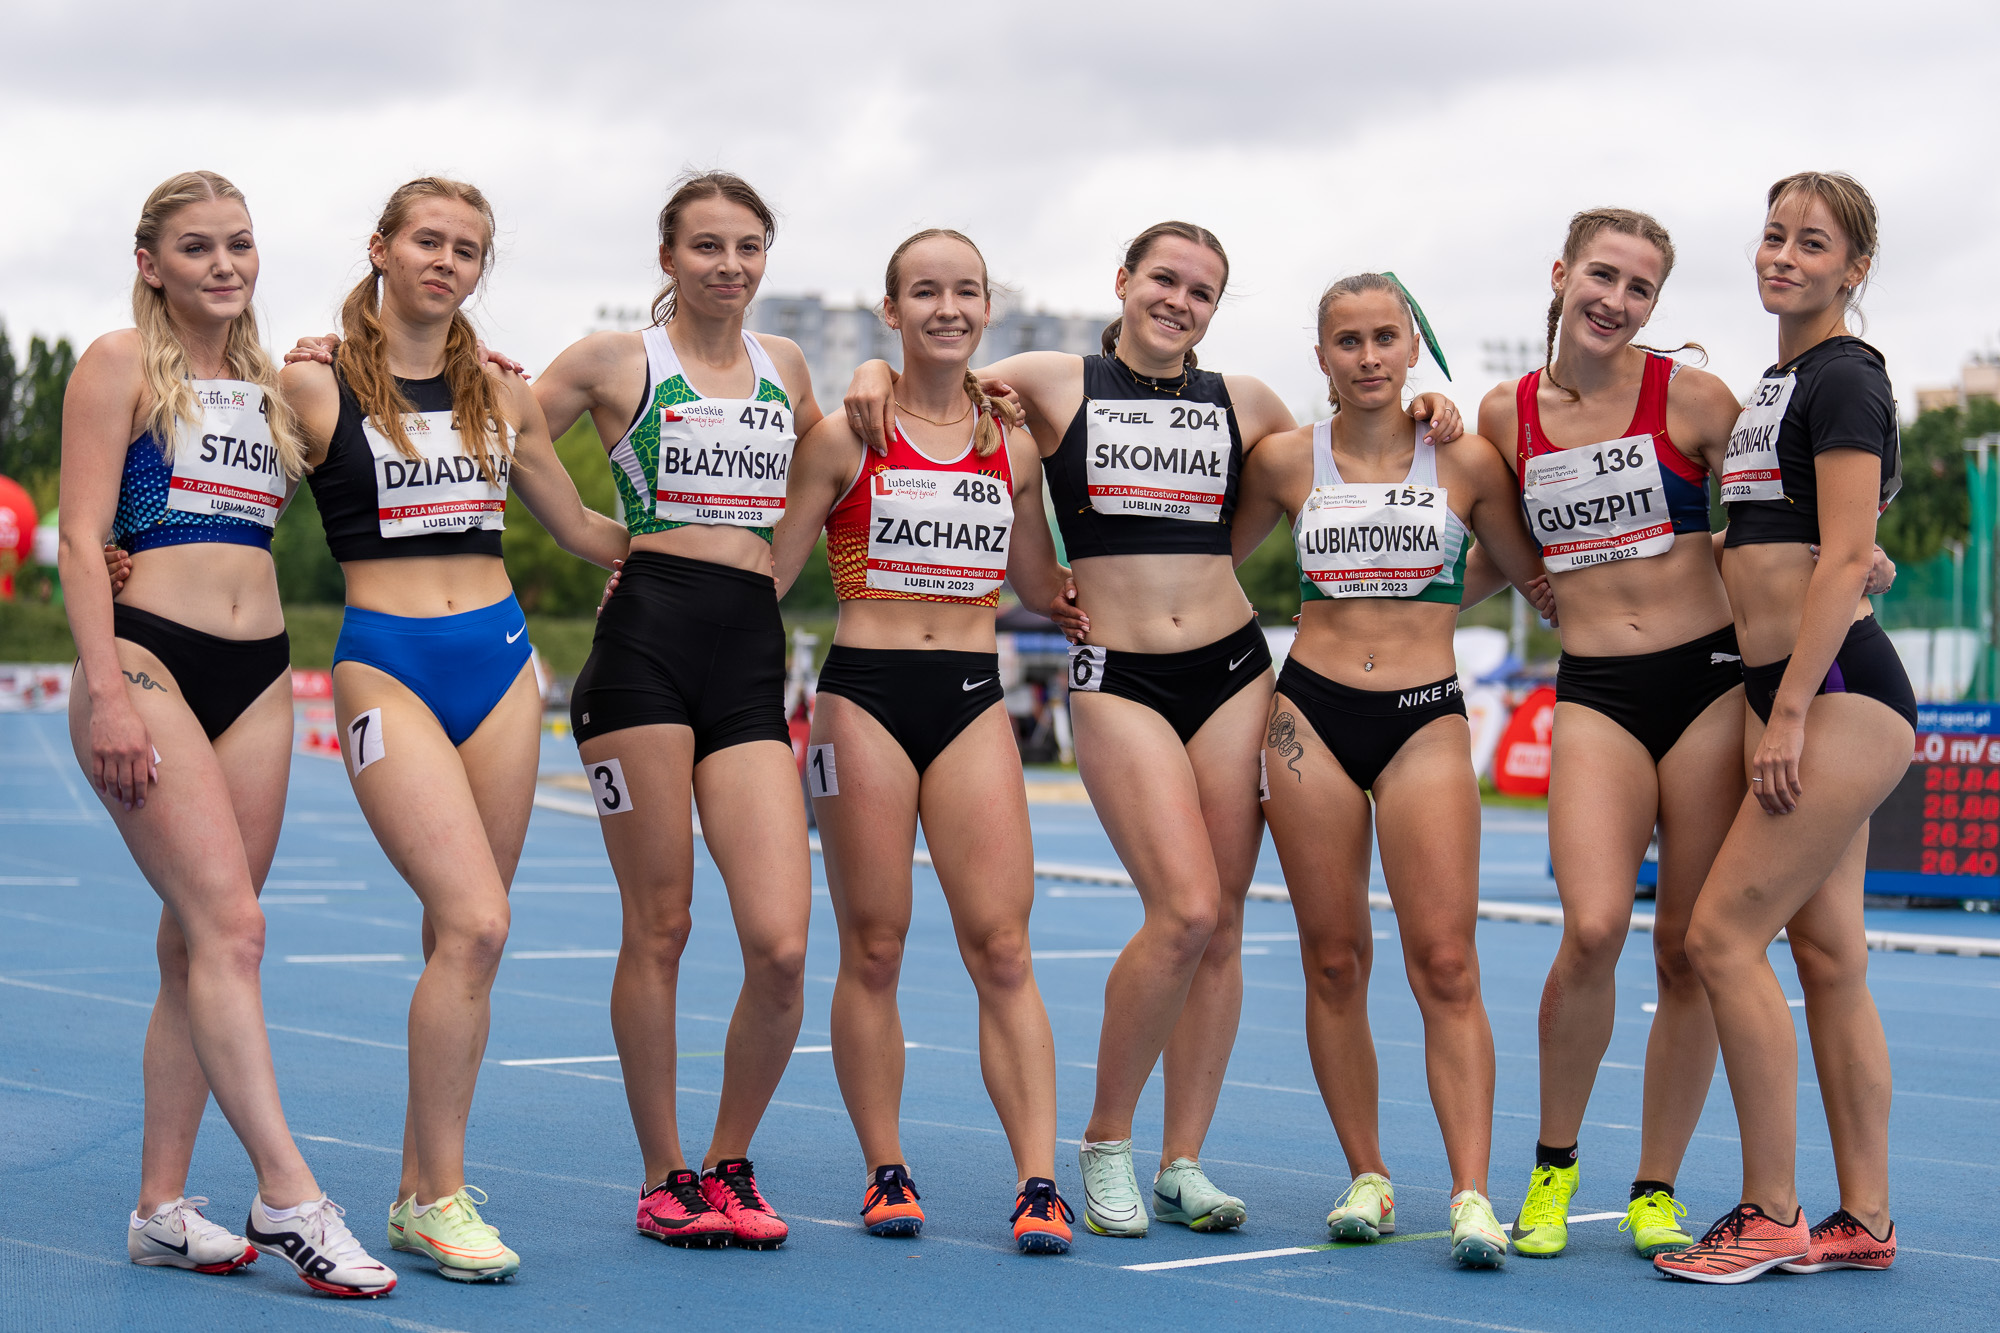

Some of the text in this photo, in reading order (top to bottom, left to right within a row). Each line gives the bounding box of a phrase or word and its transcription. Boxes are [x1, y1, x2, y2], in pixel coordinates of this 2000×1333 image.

[678, 405, 724, 416] ubelskie
[739, 406, 785, 433] 474
[1109, 412, 1154, 424] FUEL
[1169, 407, 1220, 431] 204
[200, 434, 279, 477] STASIK
[665, 442, 787, 480] BŁAŻYŃSKA
[1094, 443, 1222, 478] SKOMIAŁ
[1592, 444, 1644, 476] 136
[1758, 471, 1772, 479] U20
[182, 480, 195, 490] 77.
[197, 483, 218, 493] PZLA
[219, 487, 258, 501] Mistrzostwa
[668, 493, 680, 501] 77.
[682, 494, 702, 503] PZLA
[704, 496, 749, 506] Mistrzostwa
[953, 479, 1001, 505] 488
[1096, 486, 1217, 503] 77. PZLA Mistrzostwa Polski U20
[1384, 489, 1435, 508] 152
[1732, 485, 1751, 495] 2023
[211, 499, 266, 518] LUBLIN 2023
[391, 509, 403, 518] 77.
[405, 507, 426, 516] PZLA
[428, 502, 479, 514] Mistrzostwa
[696, 509, 763, 521] LUBLIN 2023
[1123, 500, 1190, 515] LUBLIN 2023
[1537, 487, 1653, 532] GUSZPIT
[423, 517, 466, 528] LUBLIN
[876, 517, 1007, 553] ZACHARZ
[1306, 525, 1439, 554] LUBIATOWSKA
[1550, 526, 1663, 554] 77. PZLA Mistrzostwa Polski U20
[1571, 547, 1639, 566] LUBLIN 2023
[878, 561, 890, 570] 77.
[891, 563, 911, 572] PZLA
[912, 565, 962, 576] Mistrzostwa
[963, 569, 984, 578] Polski
[1311, 568, 1435, 580] 77. PZLA Mistrzostwa Polski U20
[904, 577, 974, 591] LUBLIN 2023
[1338, 582, 1408, 593] LUBLIN 2023
[1073, 649, 1095, 686] 6
[1398, 680, 1460, 709] NIKE PR
[352, 715, 370, 766] 7
[813, 749, 828, 793] 1
[594, 766, 620, 810] 3
[282, 1231, 337, 1281] AIR
[1821, 1247, 1896, 1261] new balance
